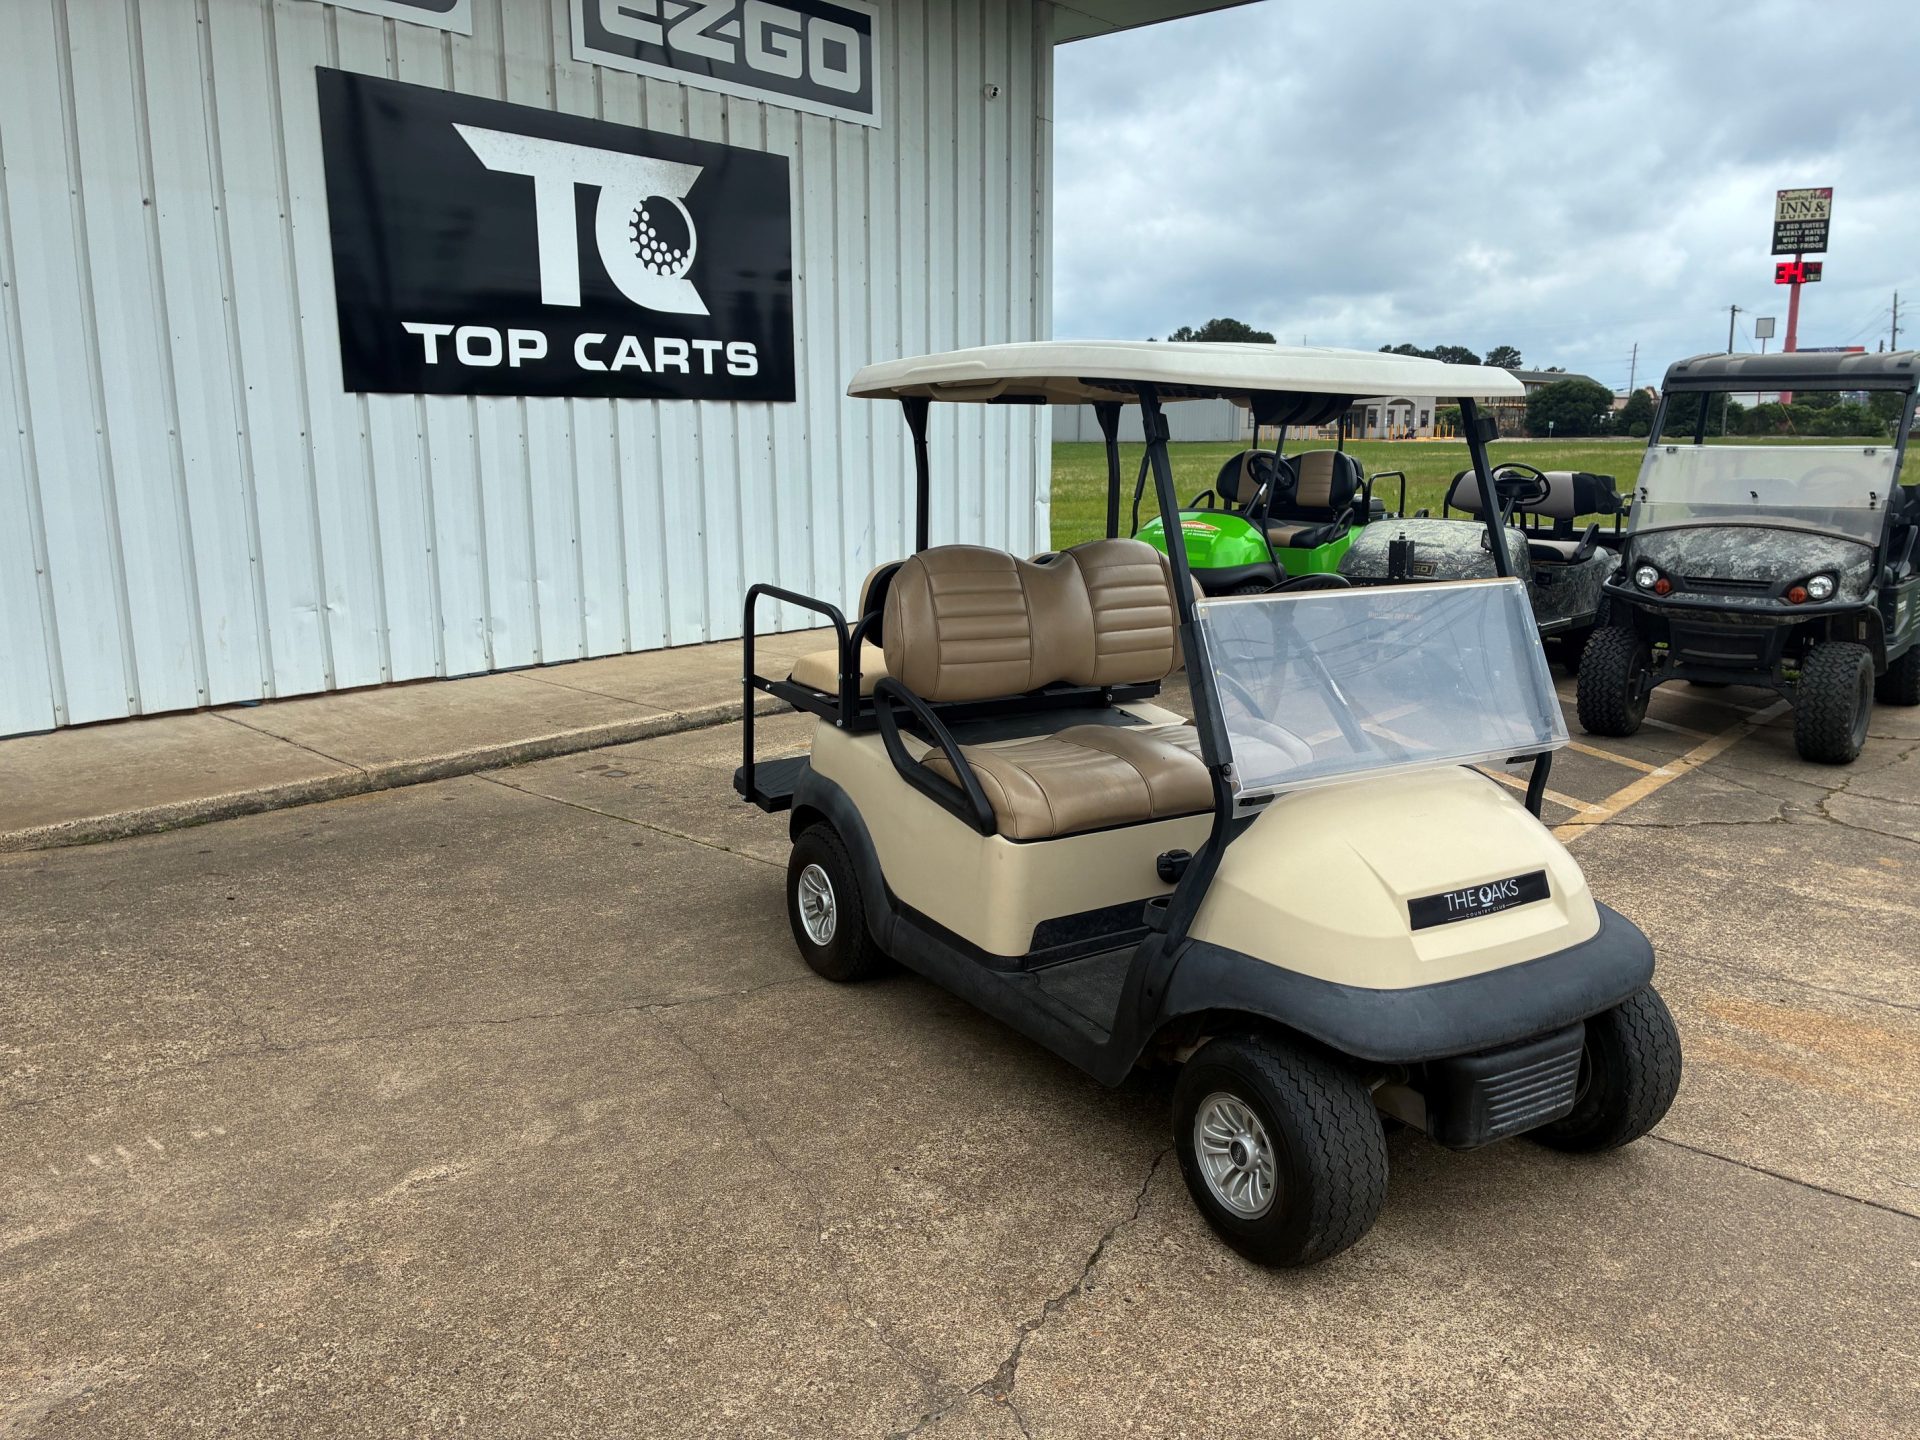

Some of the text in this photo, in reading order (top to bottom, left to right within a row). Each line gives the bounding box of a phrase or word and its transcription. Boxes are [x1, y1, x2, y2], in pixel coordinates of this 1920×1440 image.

[1780, 201, 1825, 214] INN &
[401, 321, 759, 377] TOP CARTS
[1444, 879, 1519, 911] THE OAKS
[1465, 908, 1491, 918] COUNTRY
